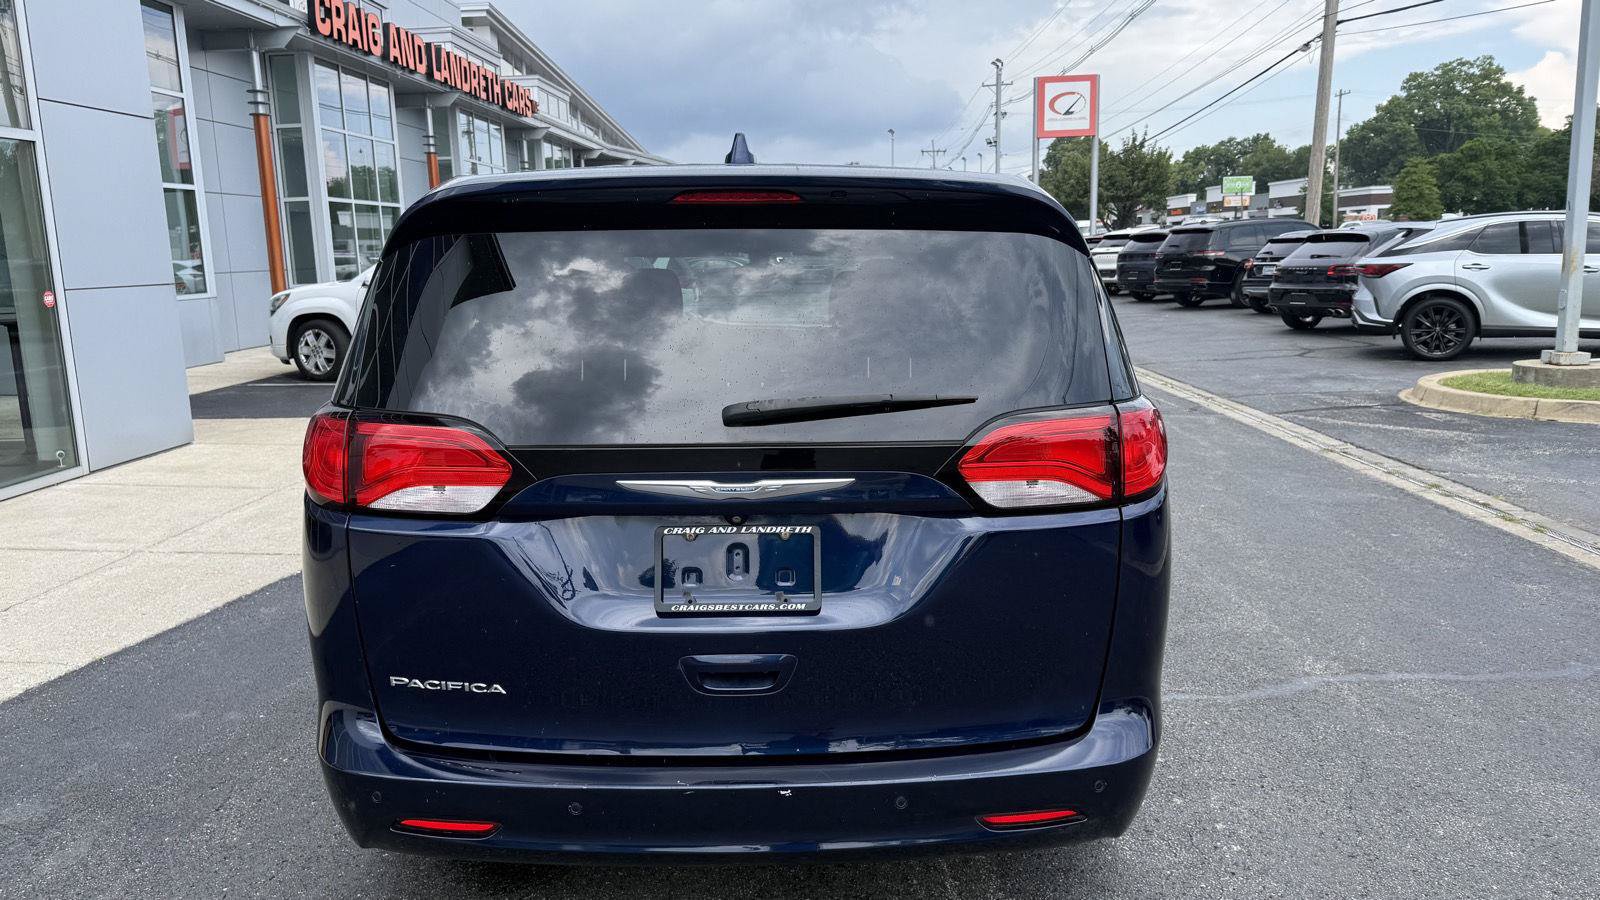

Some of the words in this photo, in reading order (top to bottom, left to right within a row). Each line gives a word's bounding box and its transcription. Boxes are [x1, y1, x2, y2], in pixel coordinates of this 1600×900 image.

[314, 0, 383, 57] CRAIG
[389, 23, 427, 74] AND
[431, 42, 502, 106] LANDRETH
[503, 80, 532, 118] CARS
[663, 526, 705, 535] CRAIG
[708, 526, 738, 534] AND
[740, 526, 812, 534] LANDRETH
[671, 603, 806, 611] CRAIGSBESTCARS.COM
[389, 676, 506, 694] PACIFICA
